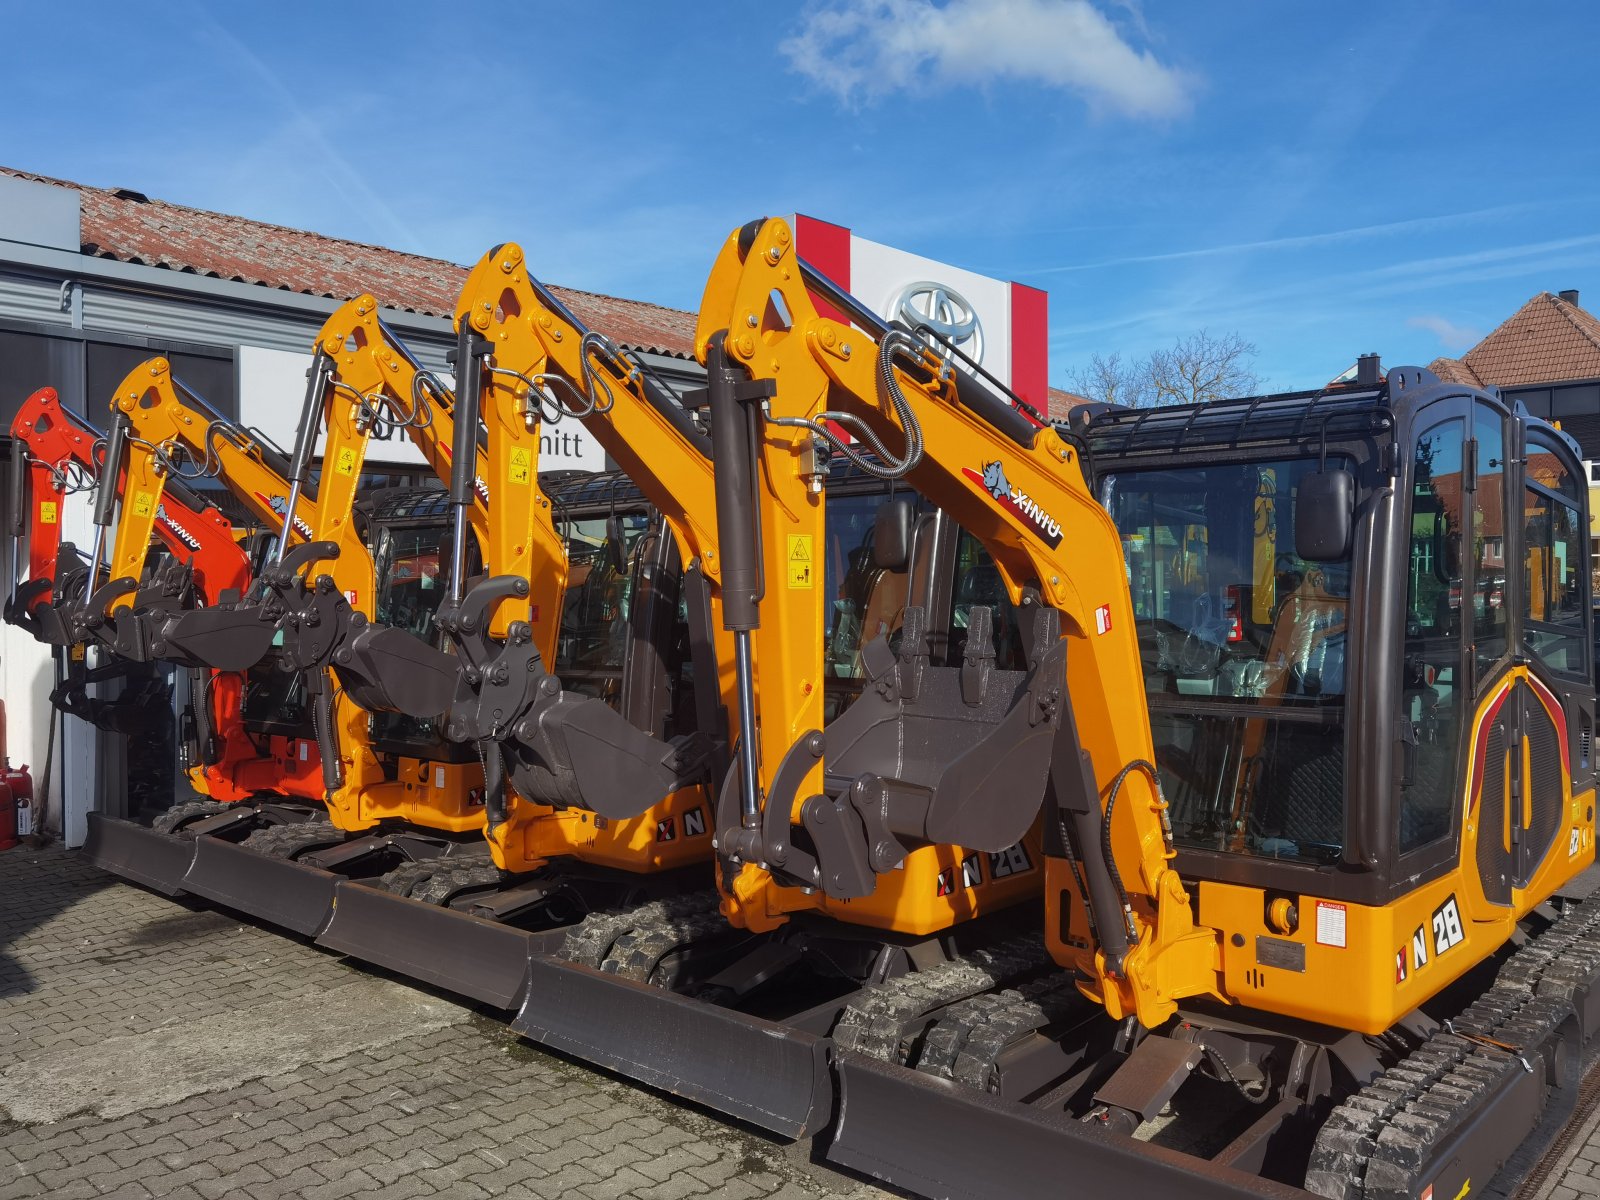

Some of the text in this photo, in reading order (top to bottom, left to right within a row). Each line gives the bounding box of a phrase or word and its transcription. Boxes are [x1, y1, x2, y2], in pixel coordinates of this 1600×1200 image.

[167, 518, 200, 549] XINIU
[1011, 488, 1063, 538] XINIU
[658, 809, 705, 842] X N
[937, 842, 1031, 897] X N 28
[1395, 899, 1464, 985] X N 28
